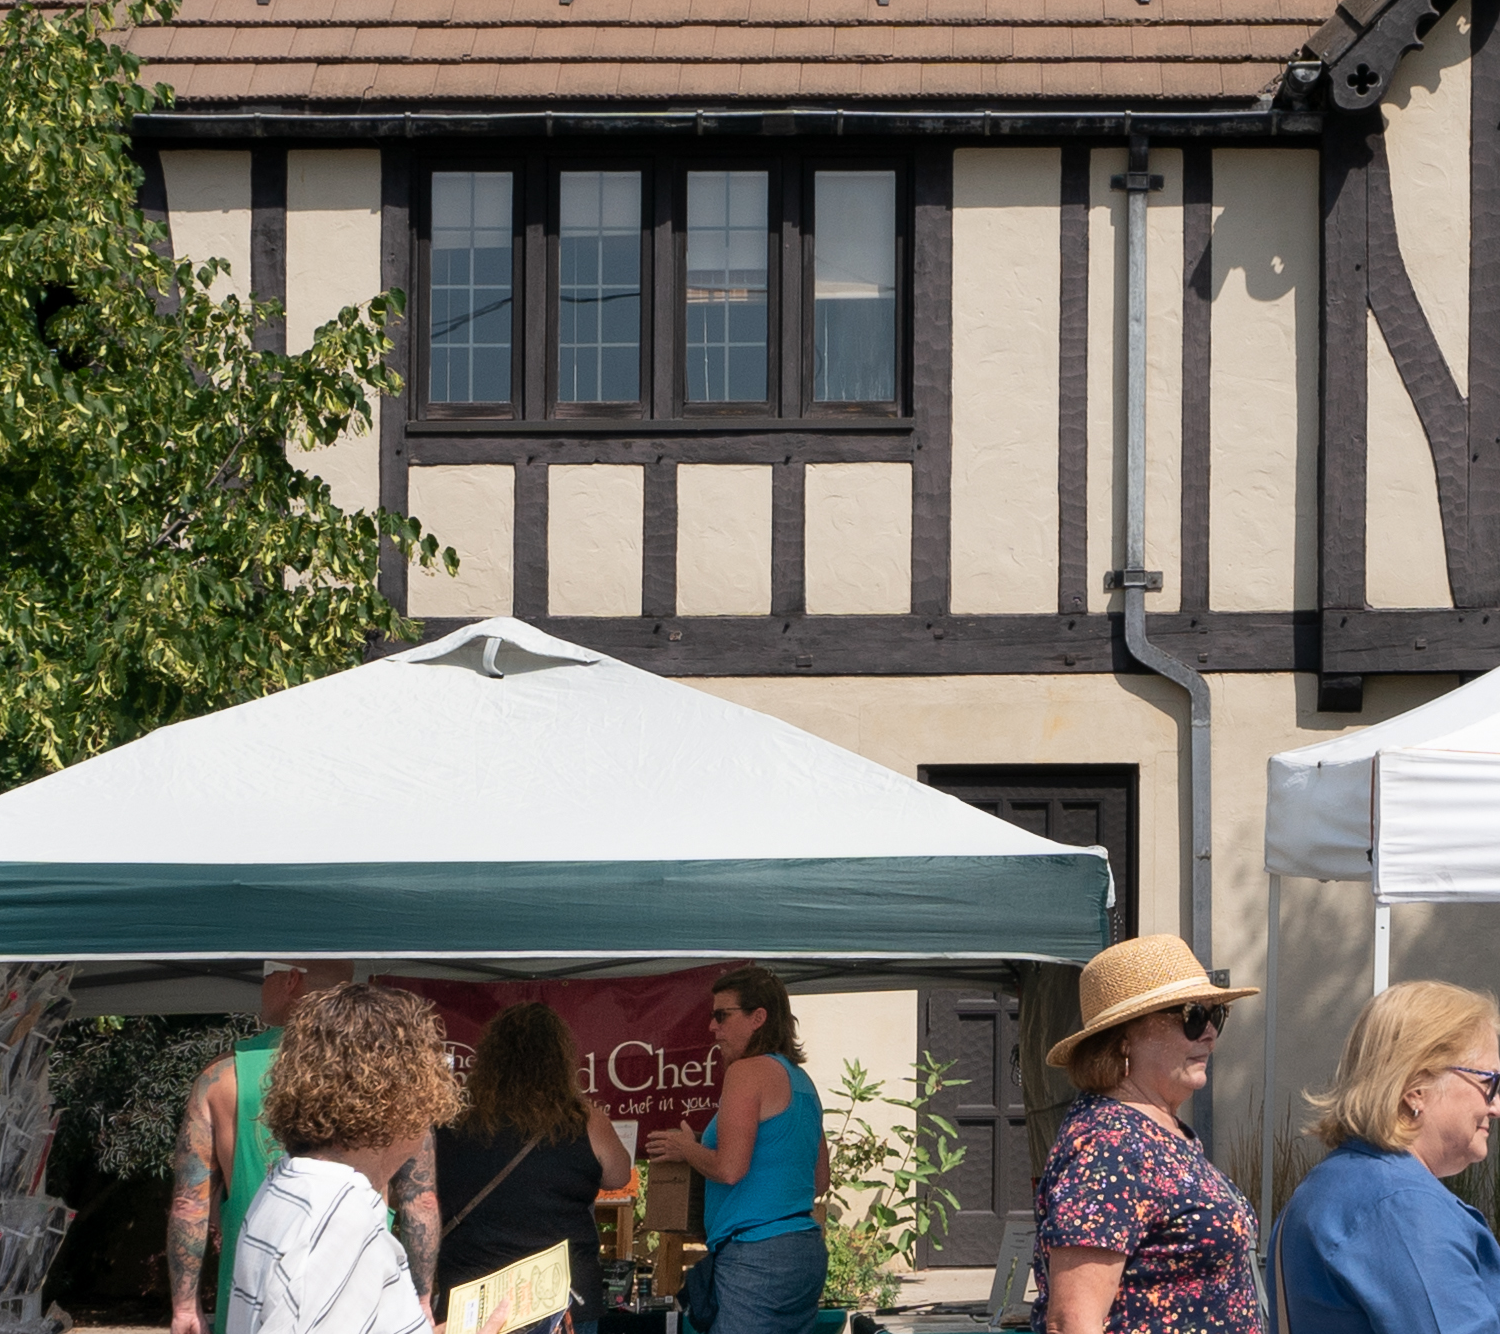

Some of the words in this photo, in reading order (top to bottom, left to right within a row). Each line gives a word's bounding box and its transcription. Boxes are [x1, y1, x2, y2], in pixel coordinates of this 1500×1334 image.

[607, 1040, 721, 1092] Chef
[618, 1095, 654, 1115] chef
[658, 1095, 674, 1112] in
